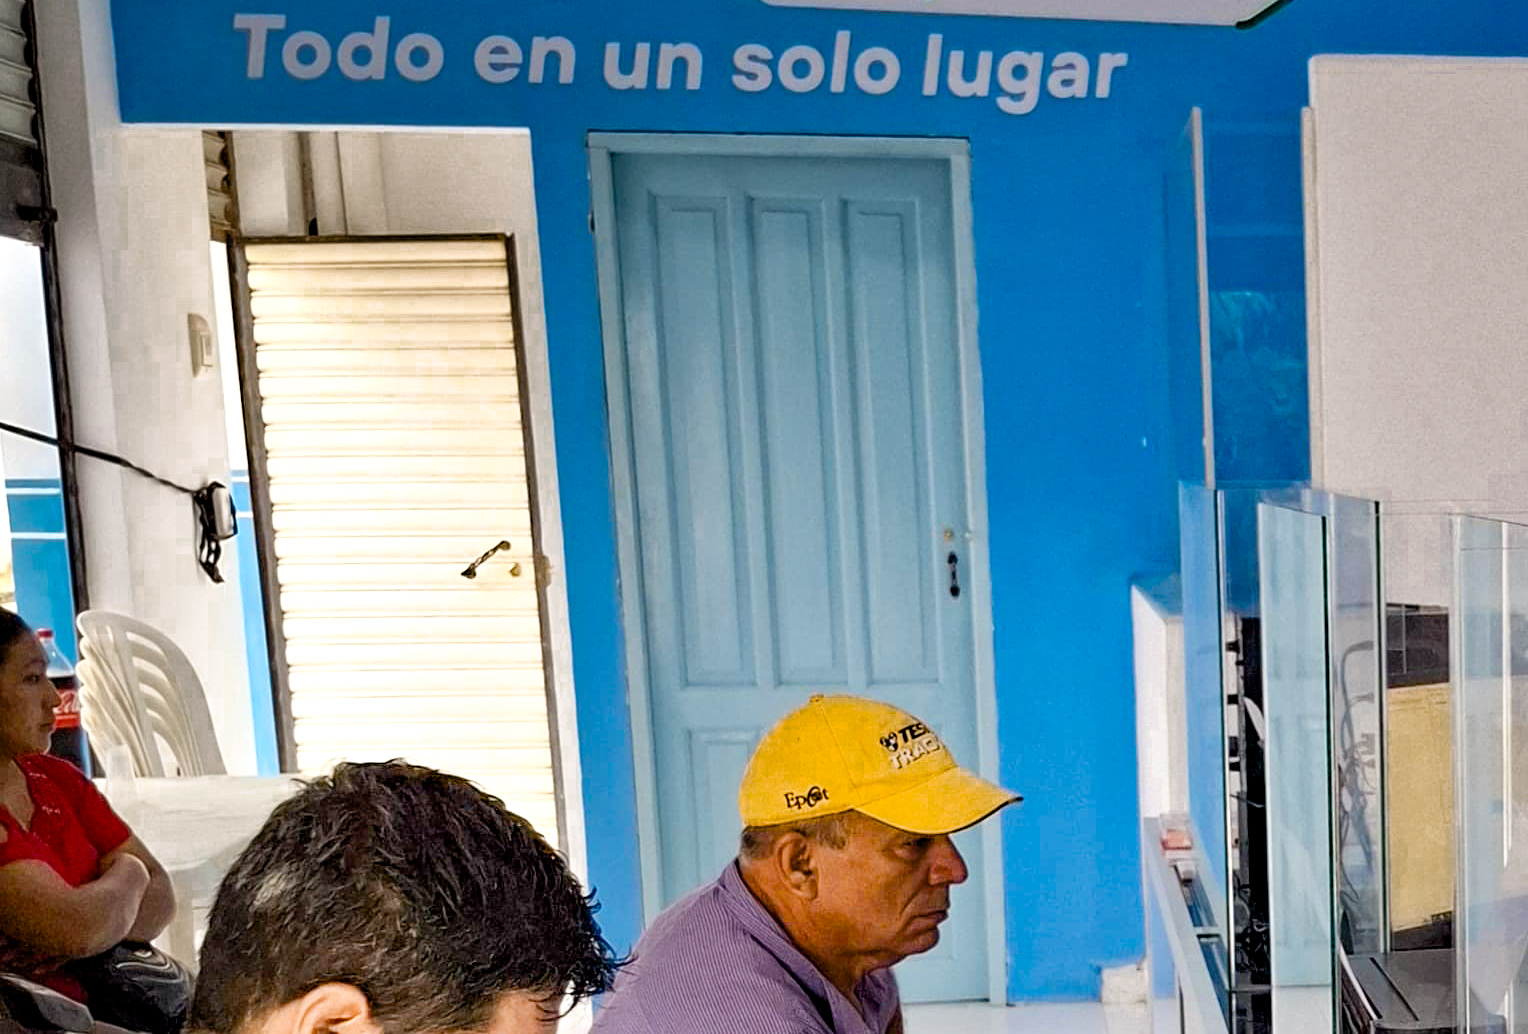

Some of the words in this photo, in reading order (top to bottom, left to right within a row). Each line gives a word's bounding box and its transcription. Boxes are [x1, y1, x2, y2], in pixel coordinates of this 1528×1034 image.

[233, 14, 443, 81] Todo
[474, 35, 575, 84] en
[603, 43, 702, 91] un
[732, 31, 901, 95] solo
[923, 34, 1127, 115] lugar
[898, 722, 929, 743] TES
